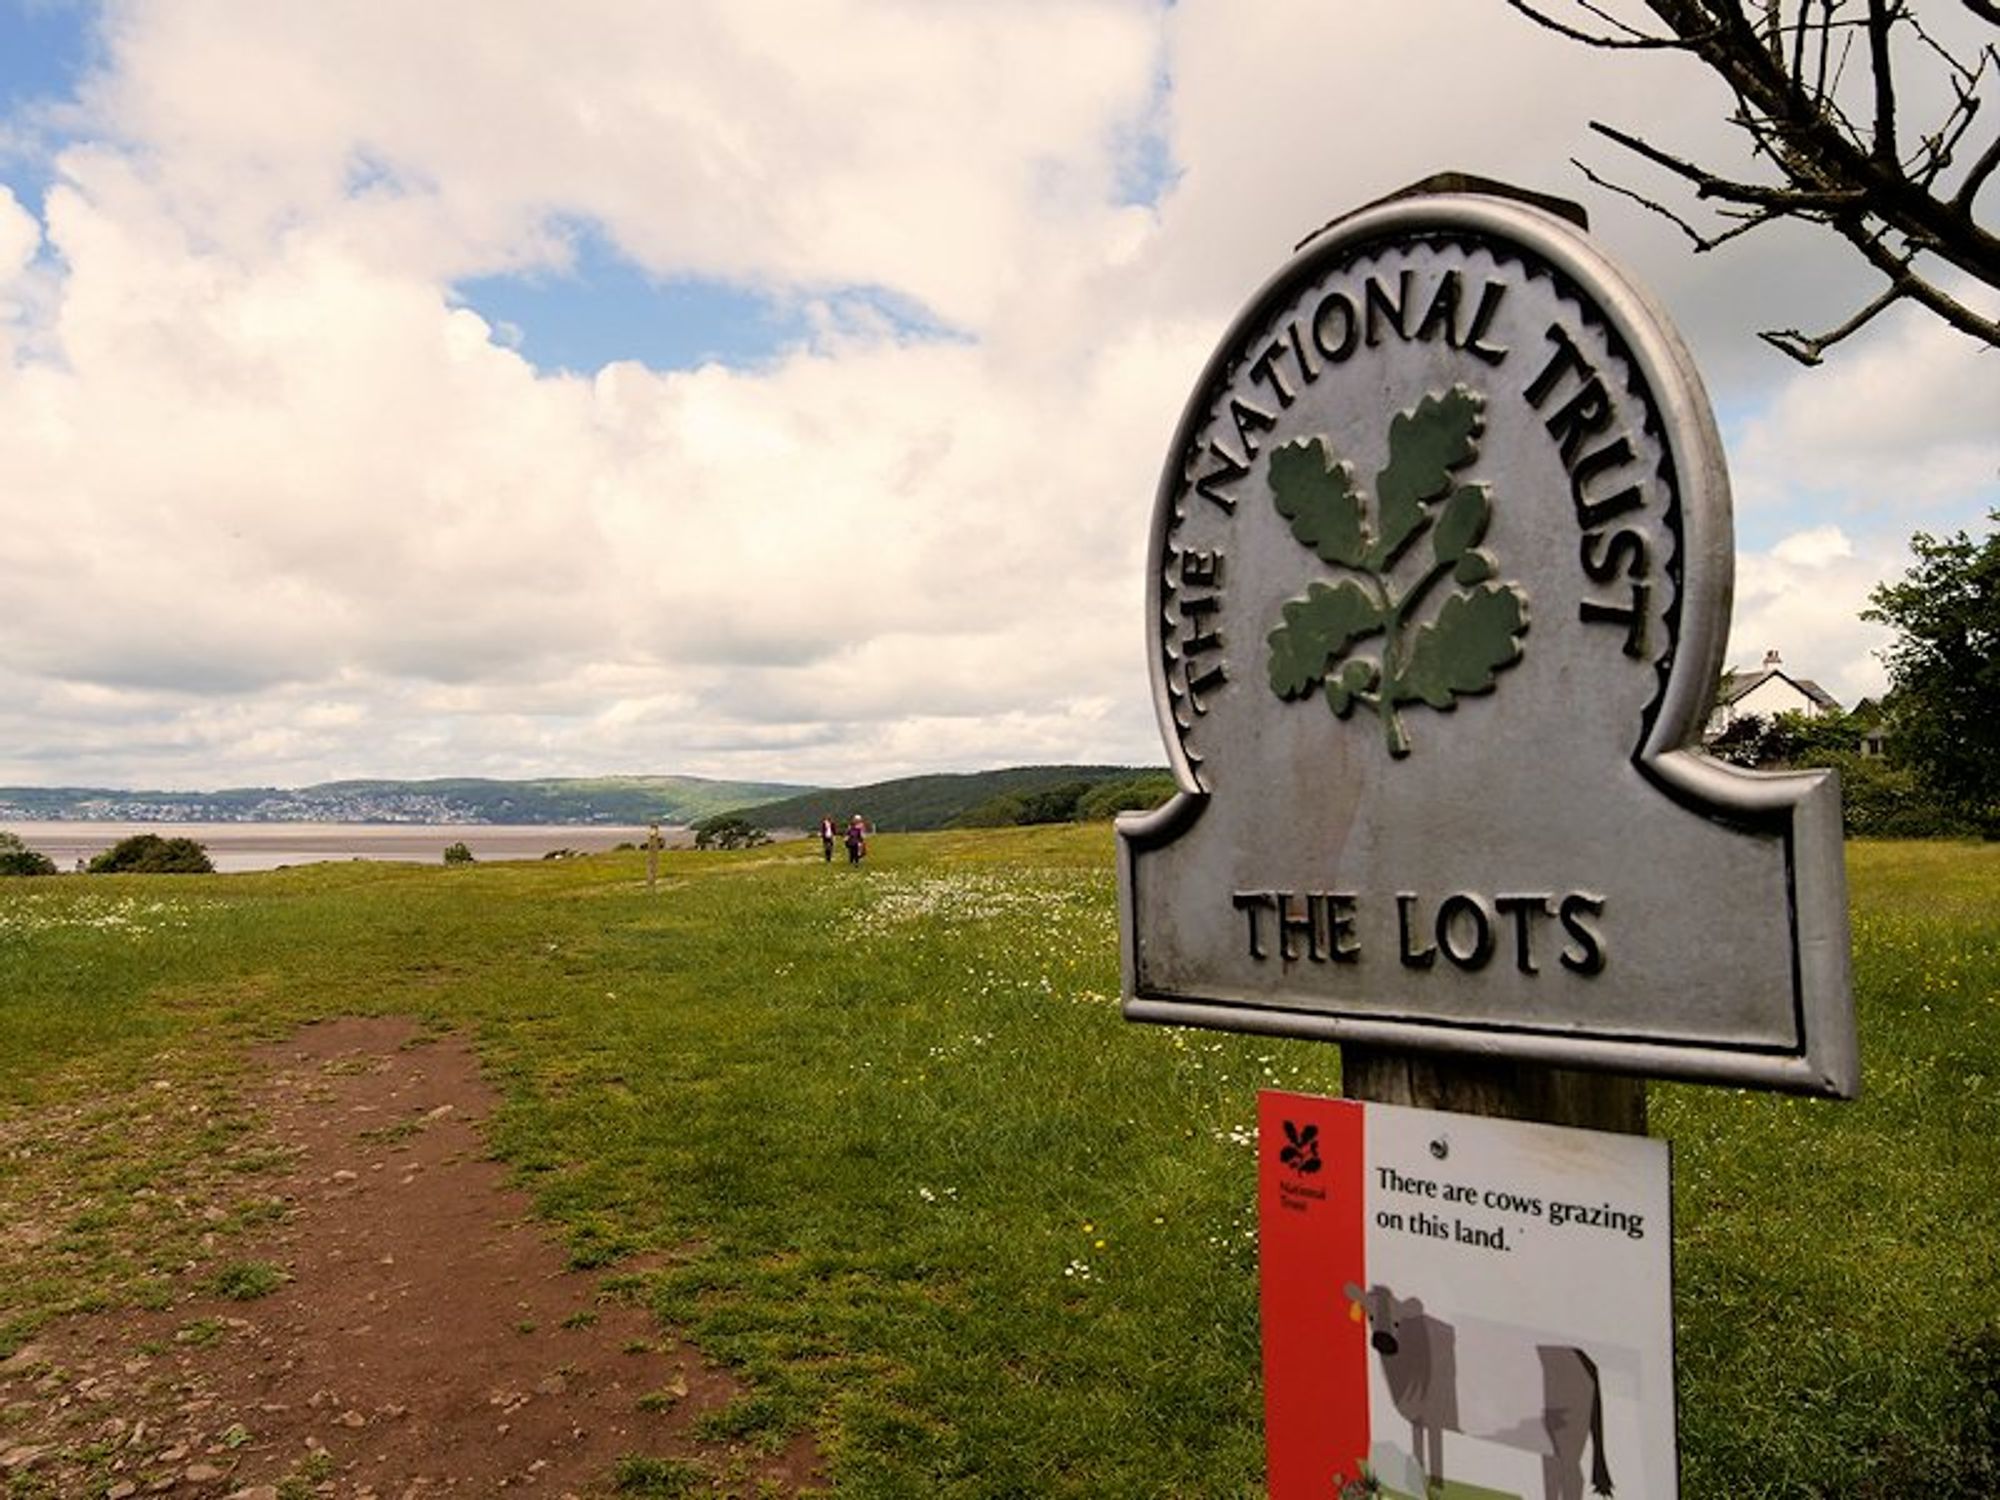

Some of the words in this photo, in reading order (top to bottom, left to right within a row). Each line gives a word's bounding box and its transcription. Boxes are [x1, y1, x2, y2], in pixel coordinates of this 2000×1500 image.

[1195, 269, 1508, 517] NATIONAL
[1522, 322, 1652, 662] TRUST
[1180, 549, 1229, 715] THE
[1233, 890, 1361, 963] THE
[1396, 890, 1607, 976] LOTS
[1376, 1167, 1438, 1199] There
[1442, 1183, 1478, 1206] are
[1484, 1190, 1542, 1217] cows
[1549, 1201, 1645, 1239] grazing
[1376, 1211, 1404, 1231] on
[1409, 1213, 1449, 1240] this
[1454, 1220, 1512, 1252] land.
